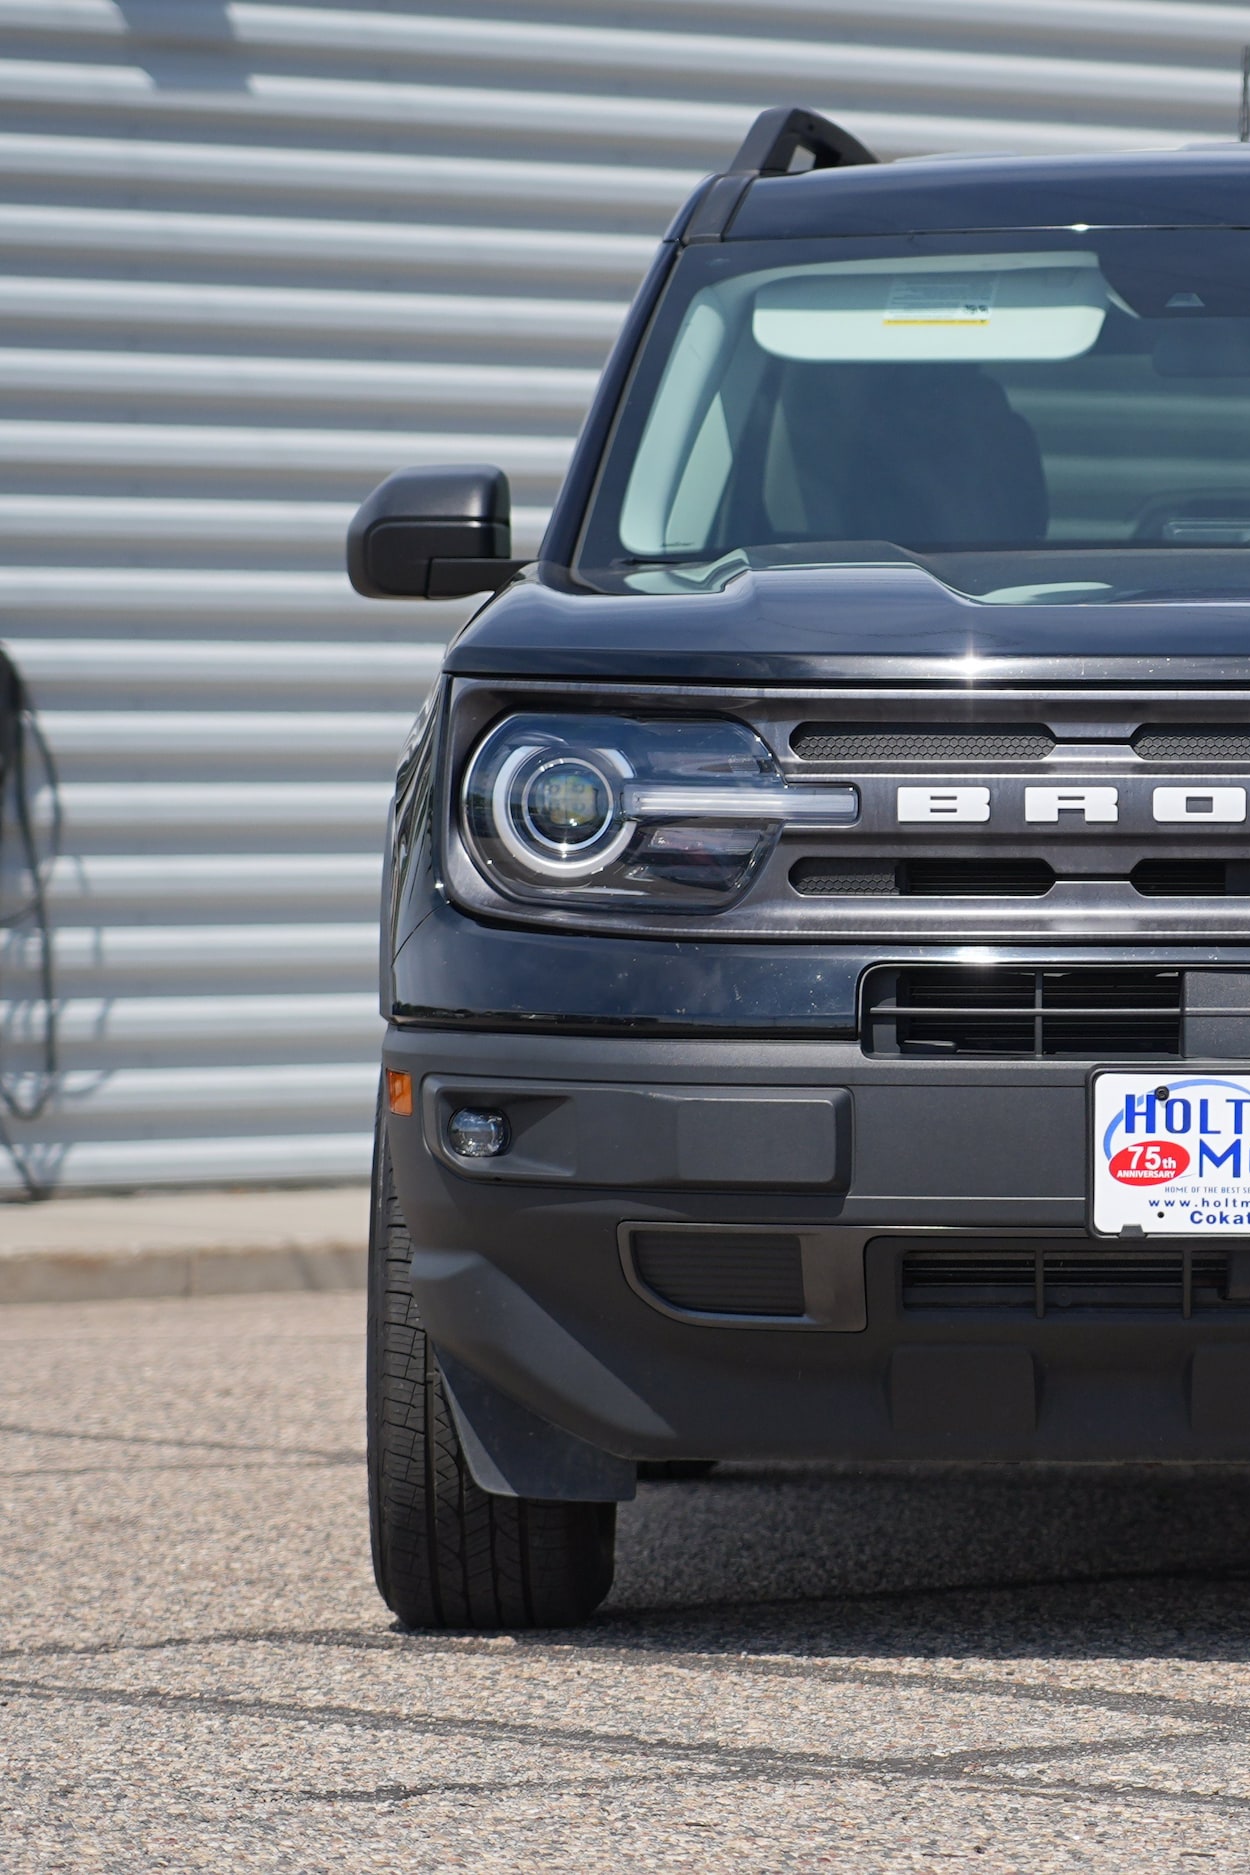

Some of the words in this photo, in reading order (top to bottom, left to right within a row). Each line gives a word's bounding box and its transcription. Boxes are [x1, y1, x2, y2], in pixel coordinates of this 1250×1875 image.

[1128, 1146, 1177, 1170] 75th
[1117, 1170, 1176, 1179] ANNIVERSARY
[1165, 1186, 1188, 1194] HOME
[1191, 1186, 1200, 1194] OF
[1204, 1186, 1219, 1194] THE
[1221, 1186, 1240, 1194] BEST
